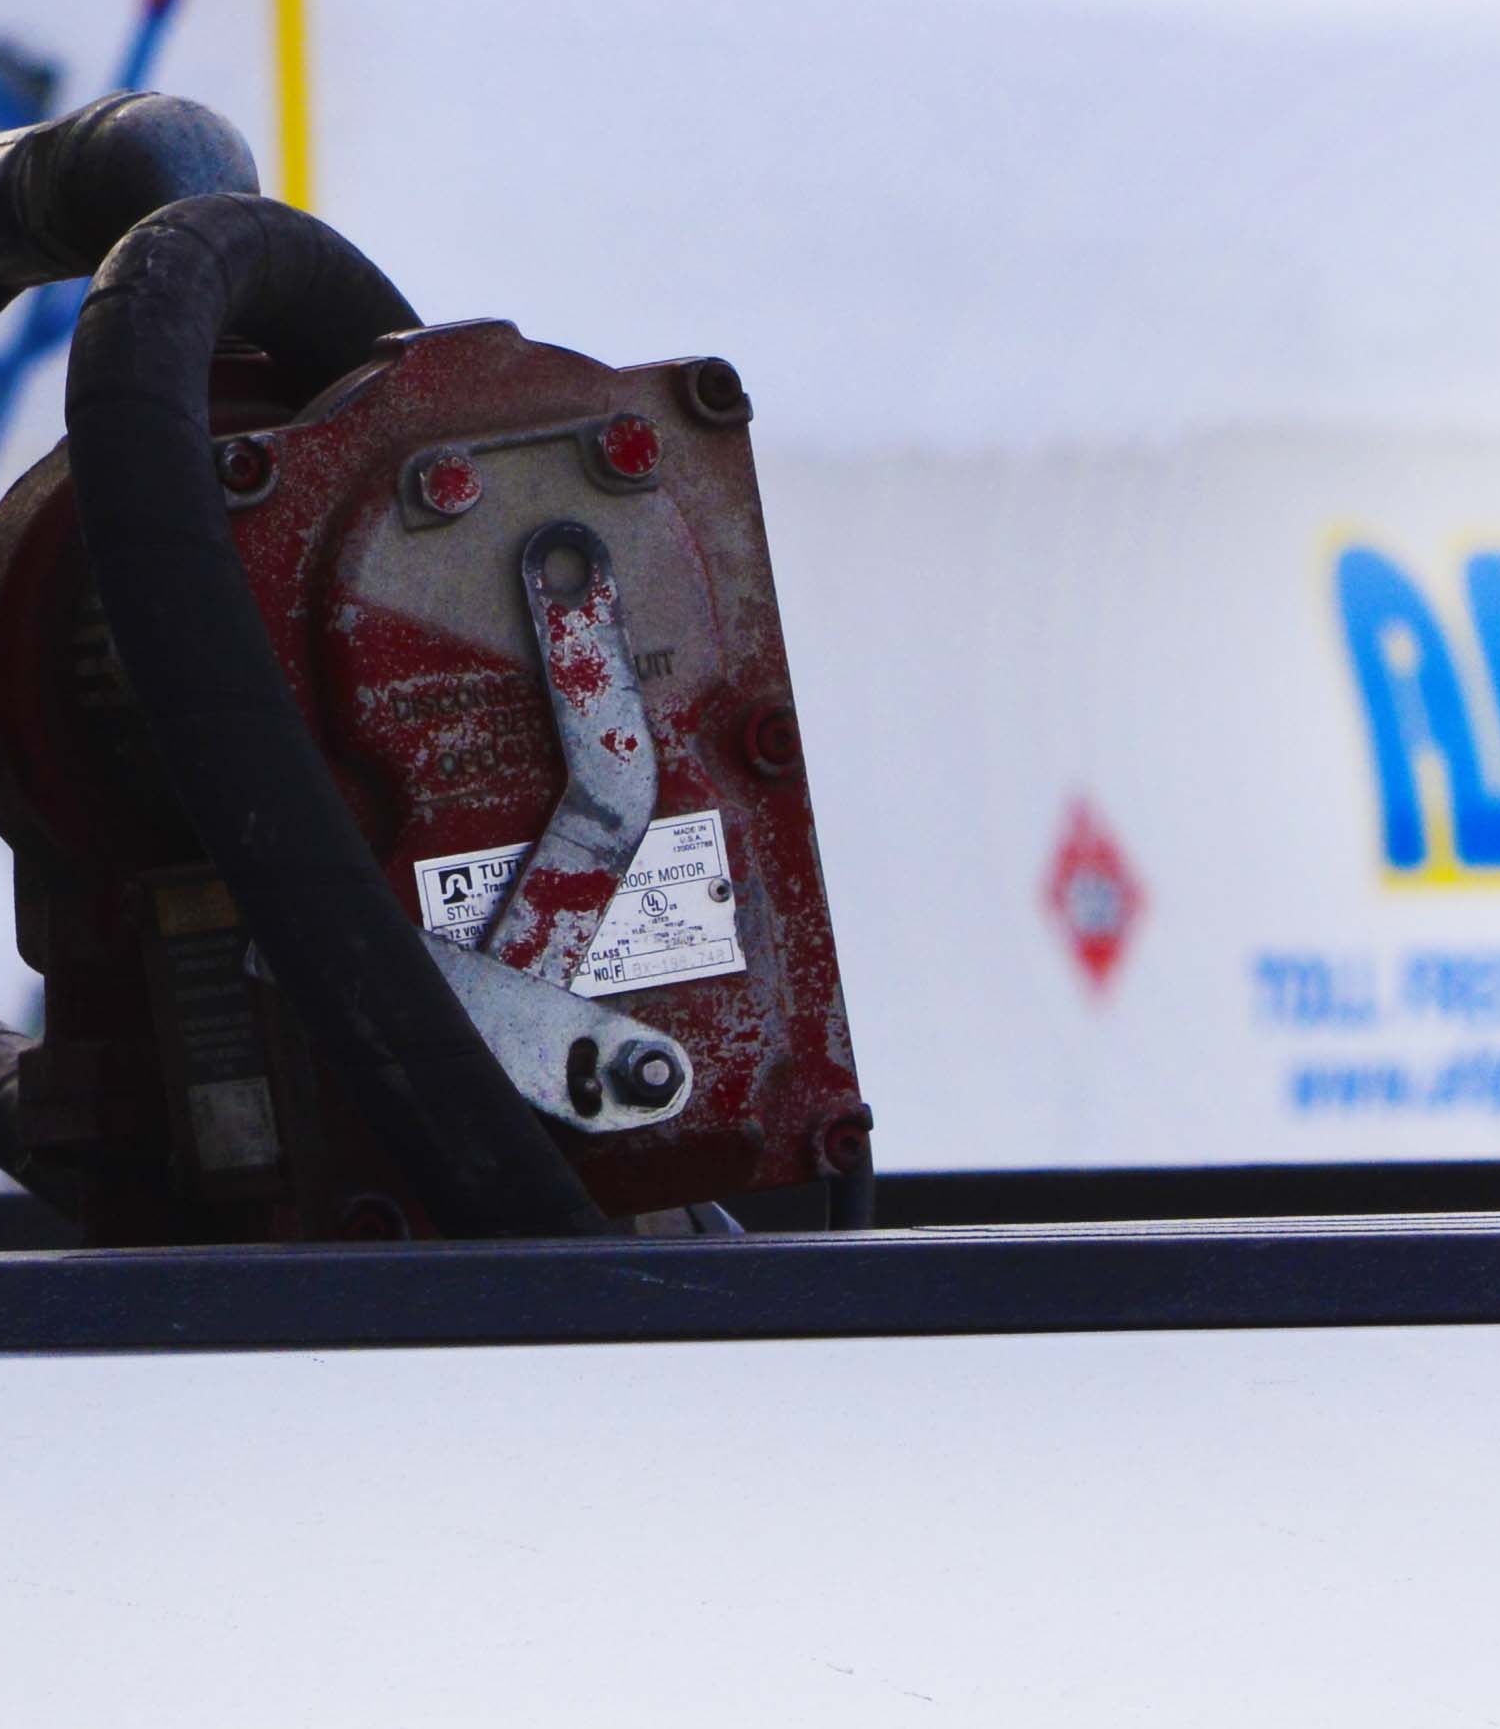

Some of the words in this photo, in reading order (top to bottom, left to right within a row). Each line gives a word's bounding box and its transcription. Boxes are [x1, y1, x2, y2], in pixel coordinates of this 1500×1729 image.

[478, 858, 519, 879] TUT
[621, 870, 653, 889] ROOF
[658, 861, 706, 883] MOTOR
[591, 947, 621, 962] CLASS
[626, 945, 632, 956] 1
[615, 965, 622, 979] F
